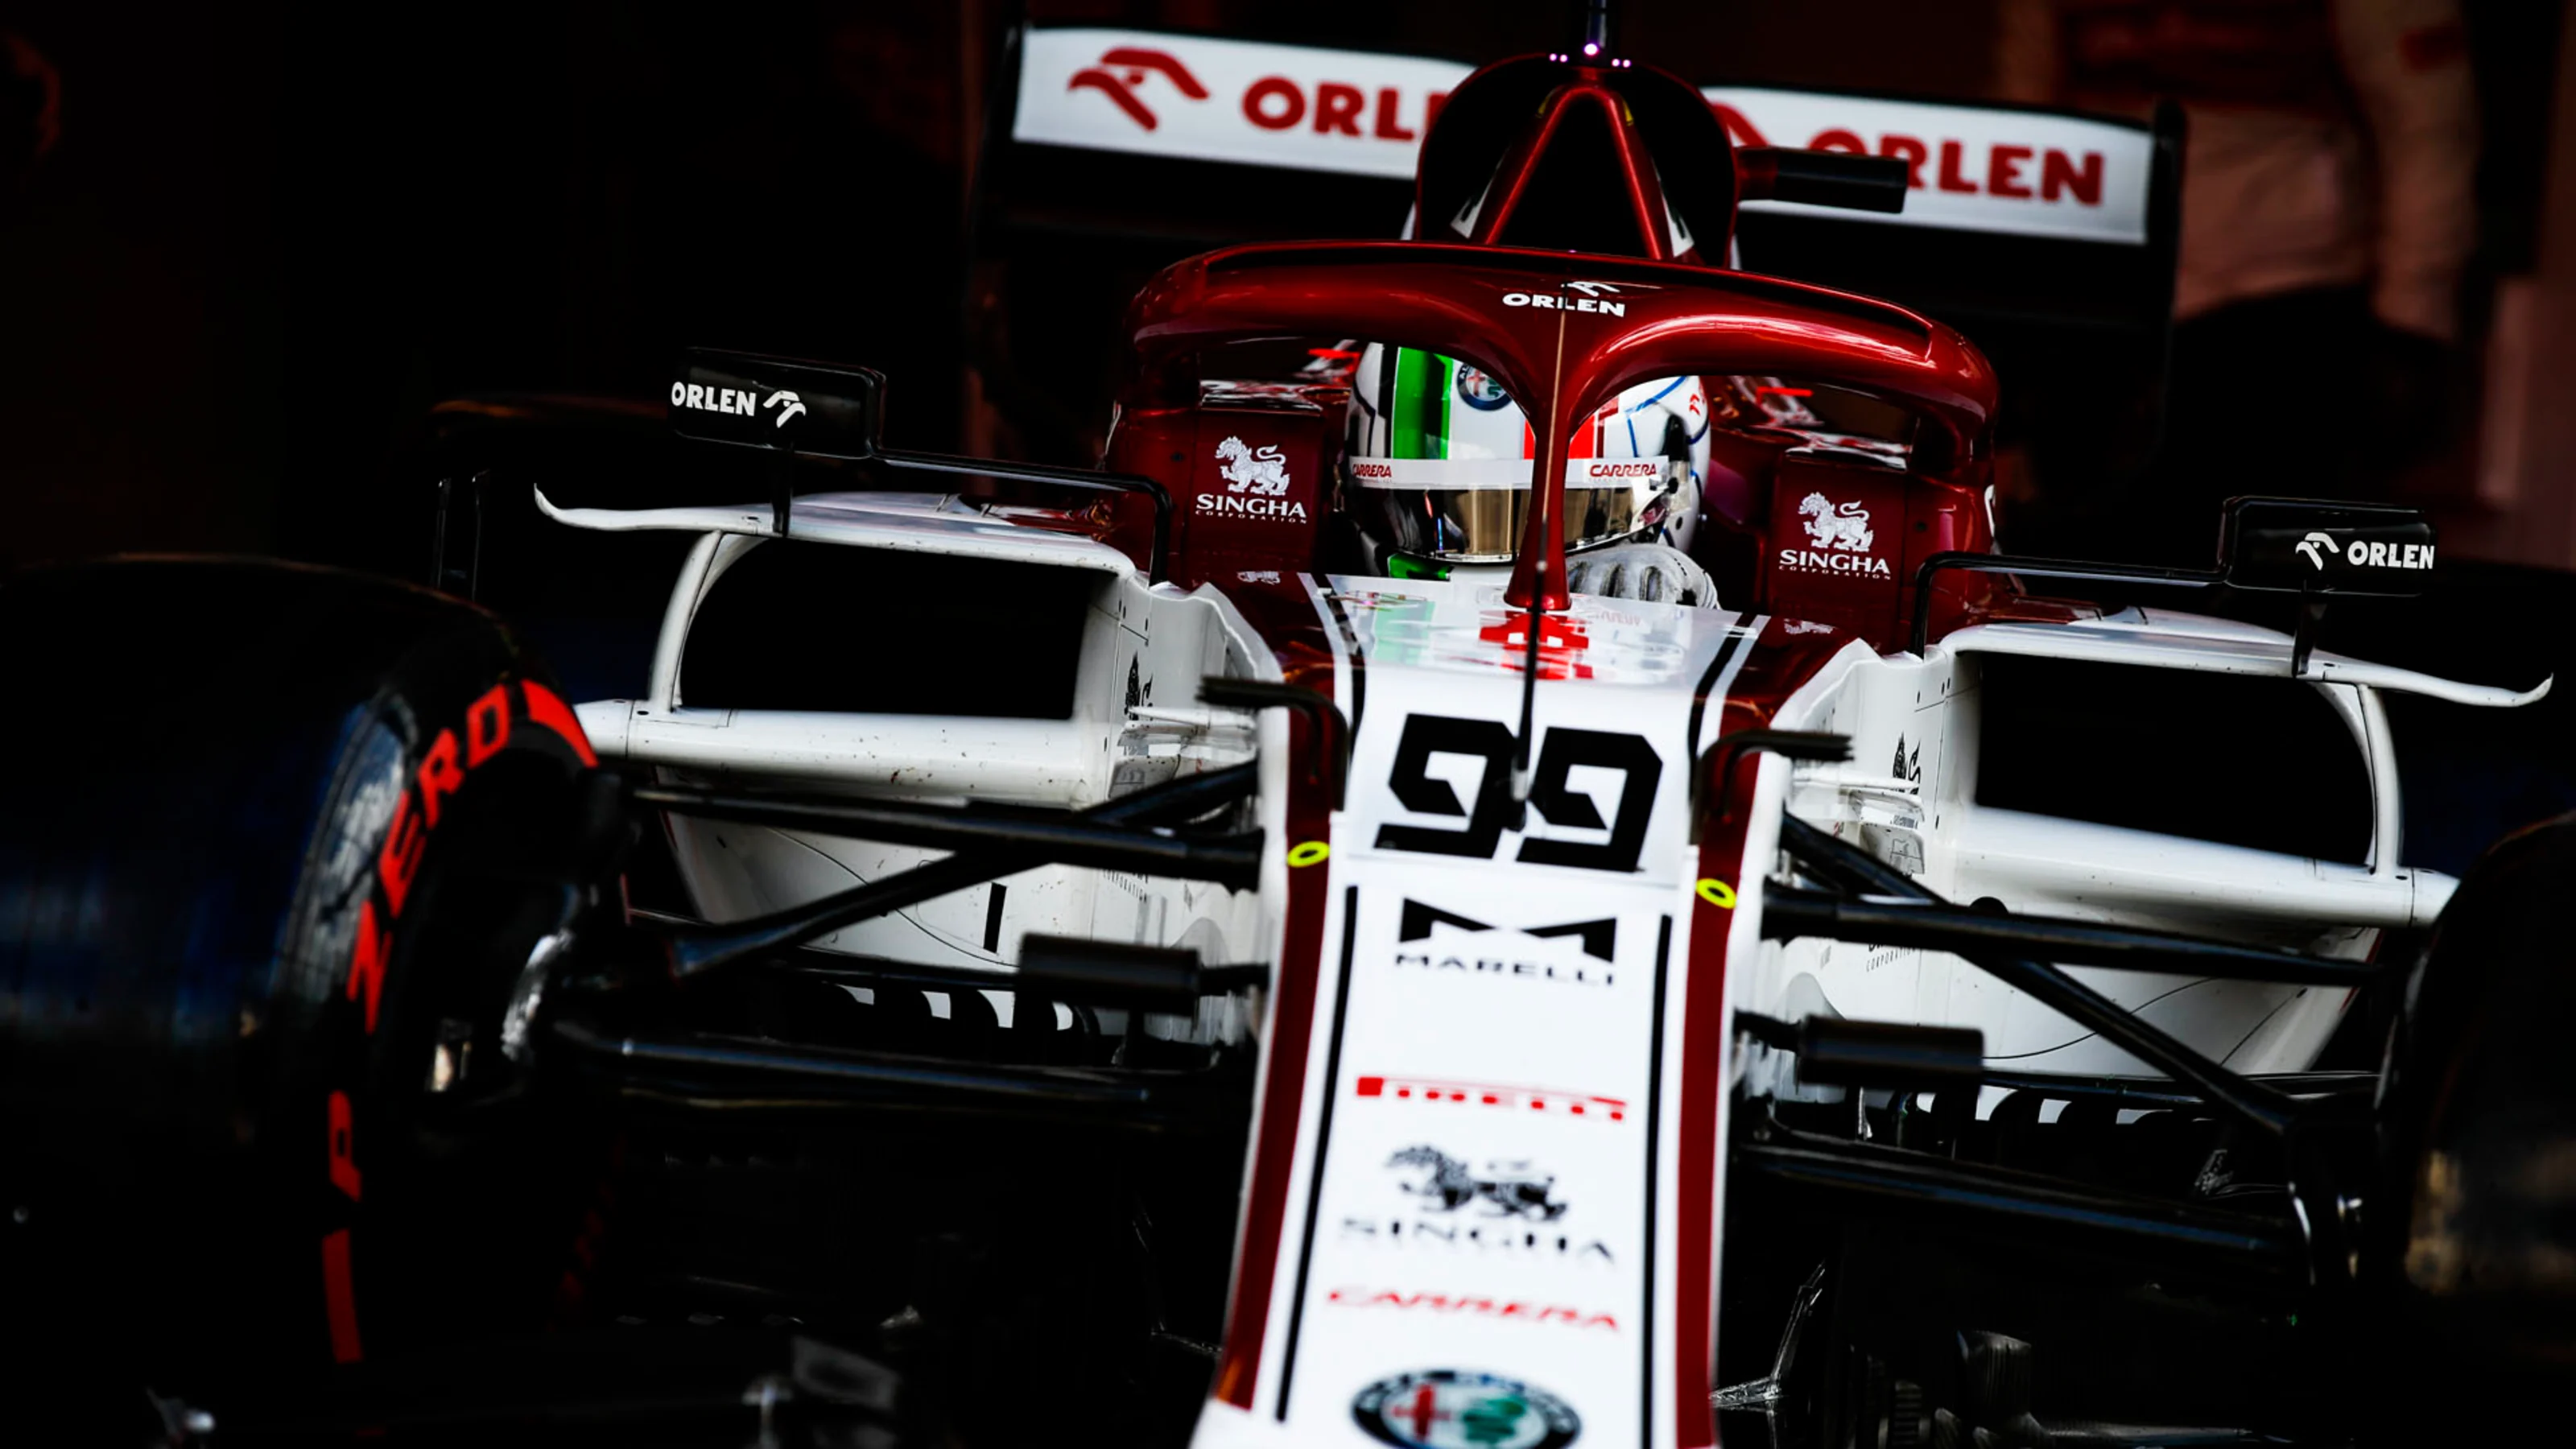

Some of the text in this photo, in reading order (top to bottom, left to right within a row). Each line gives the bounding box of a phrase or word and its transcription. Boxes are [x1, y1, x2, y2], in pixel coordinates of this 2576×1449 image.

[1241, 76, 1450, 142] ORL
[1502, 293, 1625, 317] ORLEN
[670, 382, 757, 417] ORLEN
[1352, 464, 1392, 477] CARRERA
[1590, 464, 1656, 477] CARRERA
[1195, 510, 1307, 524] CORPORATION
[1196, 493, 1307, 518] SINGHA
[1779, 549, 1891, 574] SINGHA
[2347, 541, 2434, 570] ORLEN
[1778, 565, 1891, 580] CORPORATION
[1374, 713, 1663, 873] 99
[1394, 953, 1615, 986] MARELLI
[1356, 1075, 1628, 1122] PIRELLI
[1340, 1216, 1616, 1265] SINGHA
[1327, 1286, 1620, 1331] CARRERA
